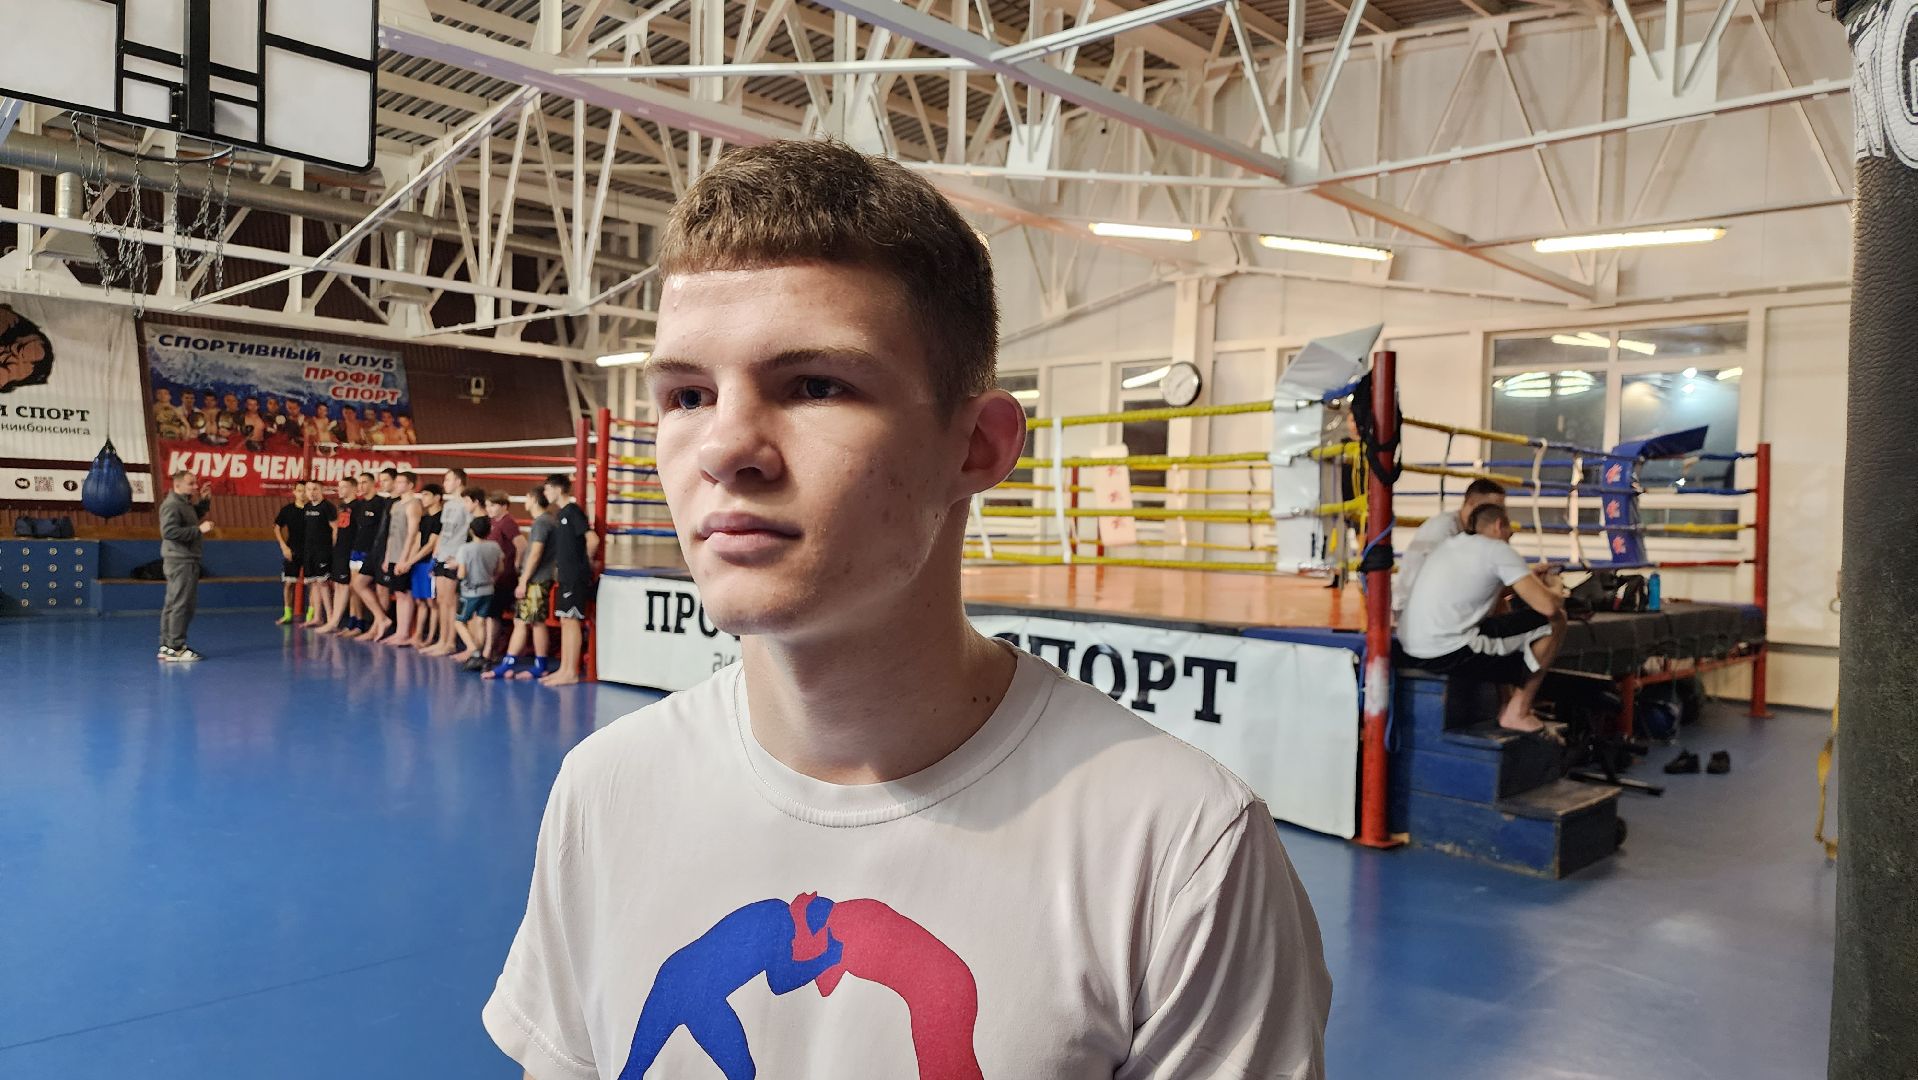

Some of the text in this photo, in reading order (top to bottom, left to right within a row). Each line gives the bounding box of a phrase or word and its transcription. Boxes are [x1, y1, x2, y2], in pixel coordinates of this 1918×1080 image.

[158, 333, 395, 369] СПОРТИВНЫЙ КЛУБ
[304, 366, 382, 386] ПРОФИ
[331, 385, 400, 402] СПОРТ
[15, 405, 90, 421] СПОРТ
[168, 451, 248, 478] КЛУБ
[992, 632, 1237, 724] ПОРТ
